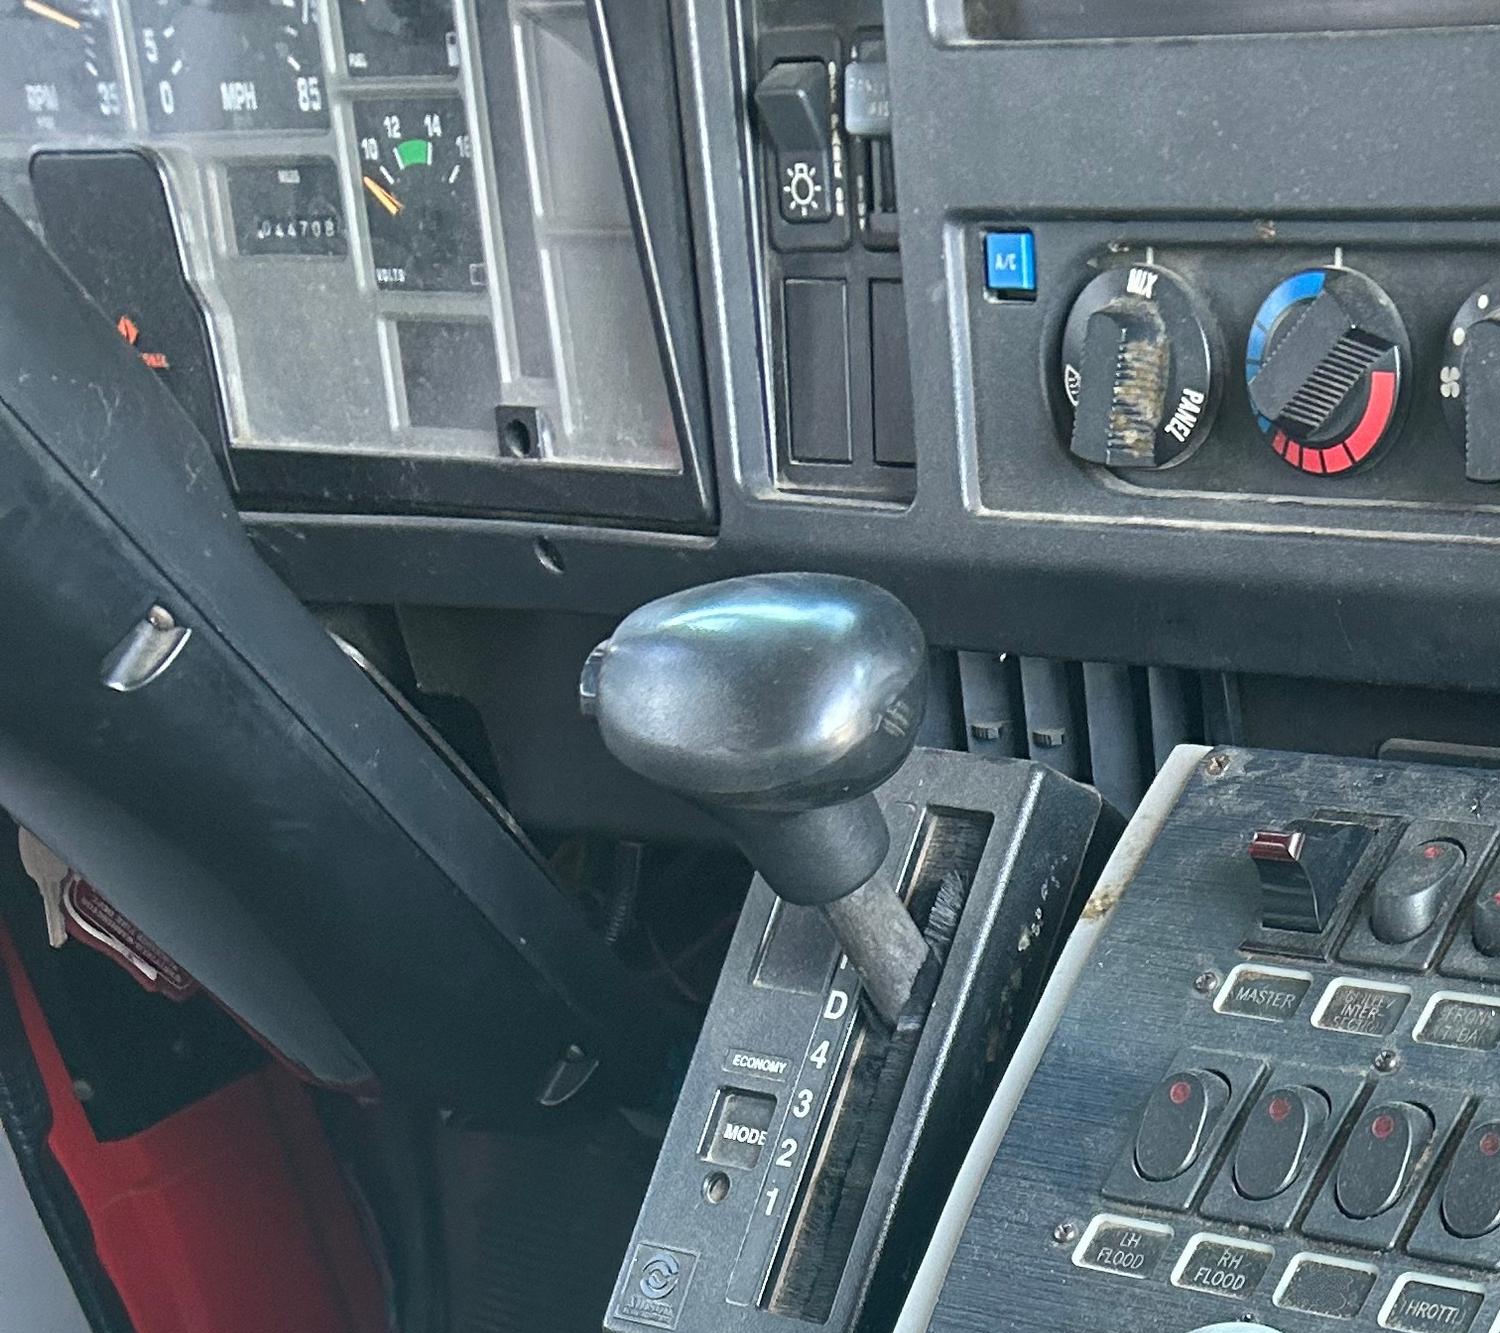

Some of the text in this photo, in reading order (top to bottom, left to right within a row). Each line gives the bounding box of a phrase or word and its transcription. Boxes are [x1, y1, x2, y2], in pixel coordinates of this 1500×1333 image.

[220, 81, 258, 111] MPH
[297, 76, 322, 112] 85
[383, 115, 402, 138] 12
[423, 113, 442, 137] 14
[361, 137, 380, 161] 10
[995, 252, 1017, 271] A/C
[376, 268, 406, 282] VOLTS
[1127, 267, 1158, 298] MIX
[1164, 388, 1205, 444] PANEL
[823, 990, 849, 1020] D
[1235, 986, 1296, 1010] MASTER
[732, 1054, 788, 1074] ECONOMY
[810, 1040, 831, 1071] 4
[793, 1088, 813, 1118] 3
[723, 1123, 768, 1146] MODE
[775, 1138, 798, 1168] 2
[765, 1187, 780, 1216] 1
[1119, 1230, 1142, 1249] LH
[1096, 1248, 1145, 1270] FLOOD
[1217, 1251, 1243, 1270] RH
[1193, 1268, 1247, 1290] FLOOD
